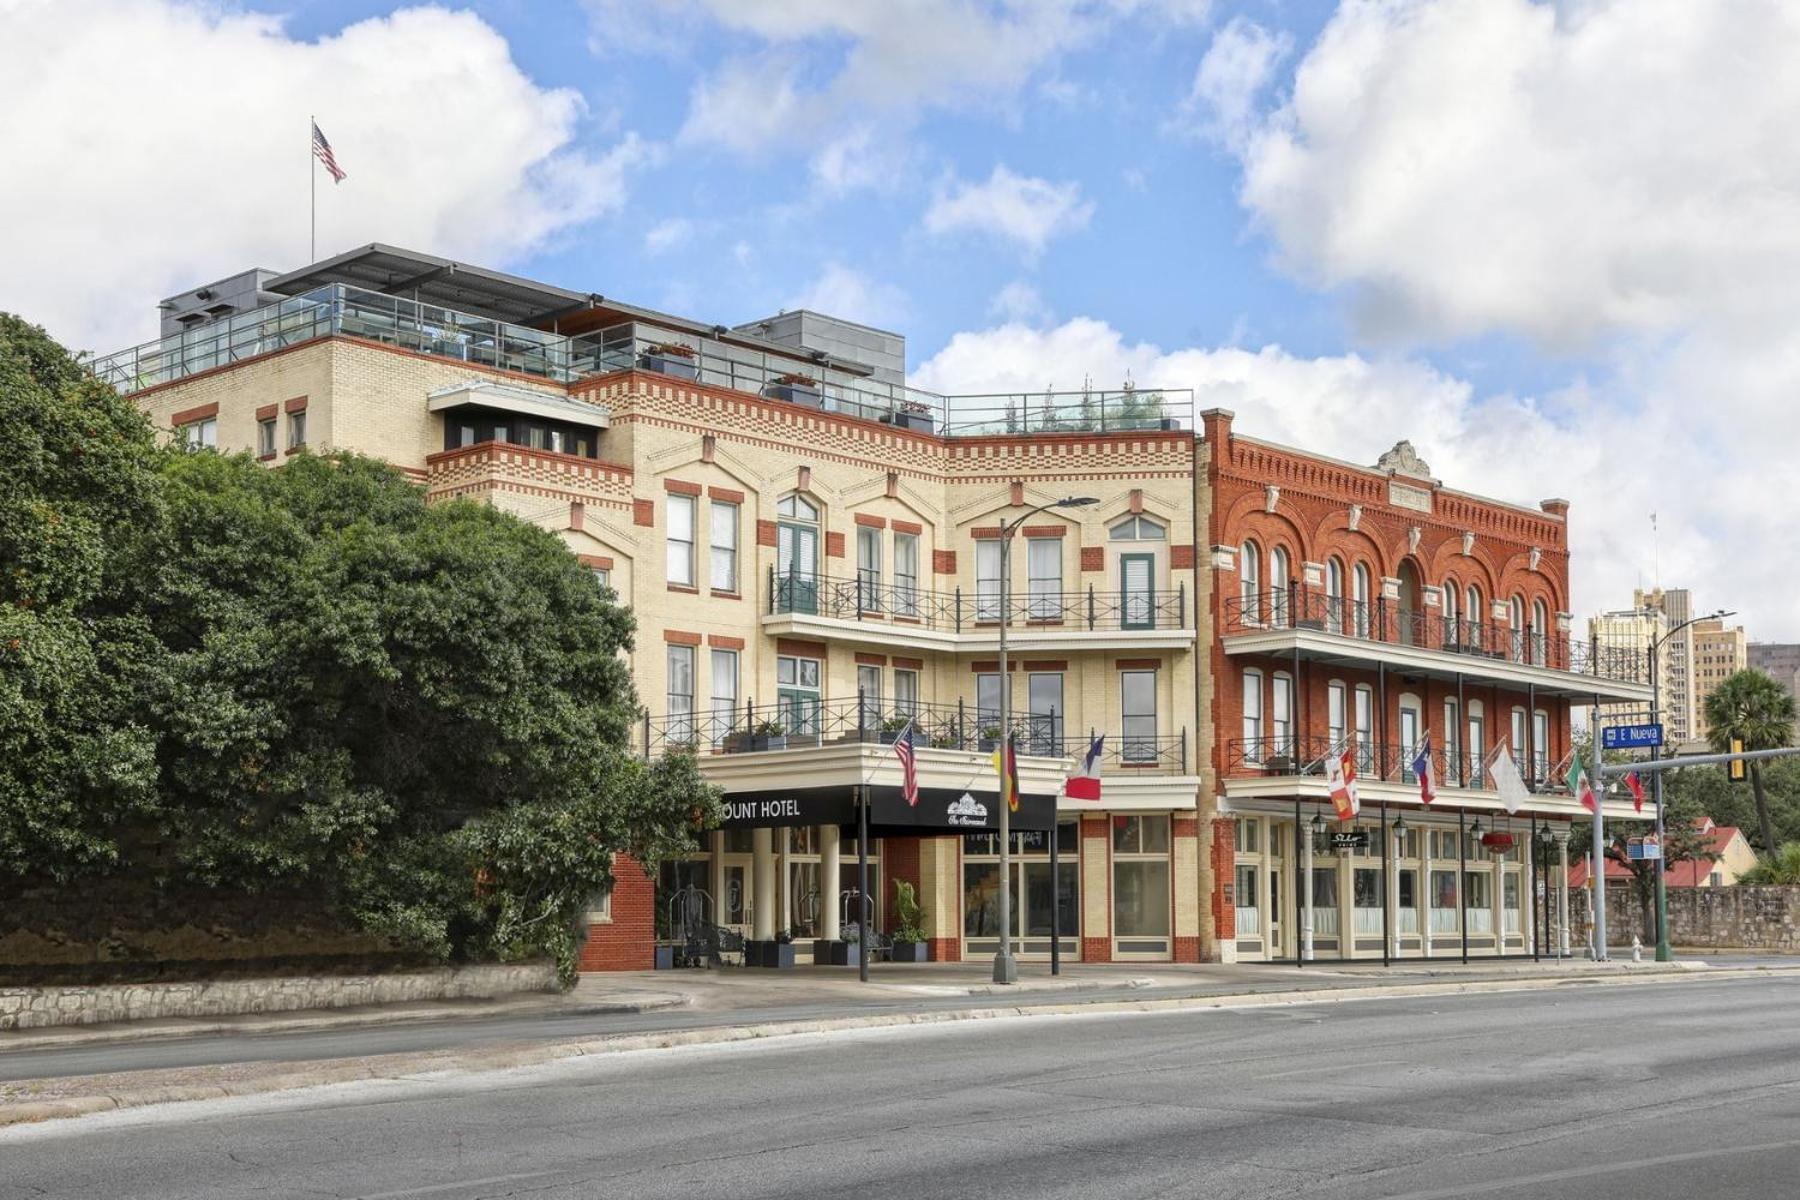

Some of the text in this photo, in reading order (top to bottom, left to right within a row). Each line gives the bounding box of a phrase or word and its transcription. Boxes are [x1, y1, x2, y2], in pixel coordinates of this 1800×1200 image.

[1621, 727, 1657, 740] E Nueva
[722, 799, 800, 819] OUNT HOTEL
